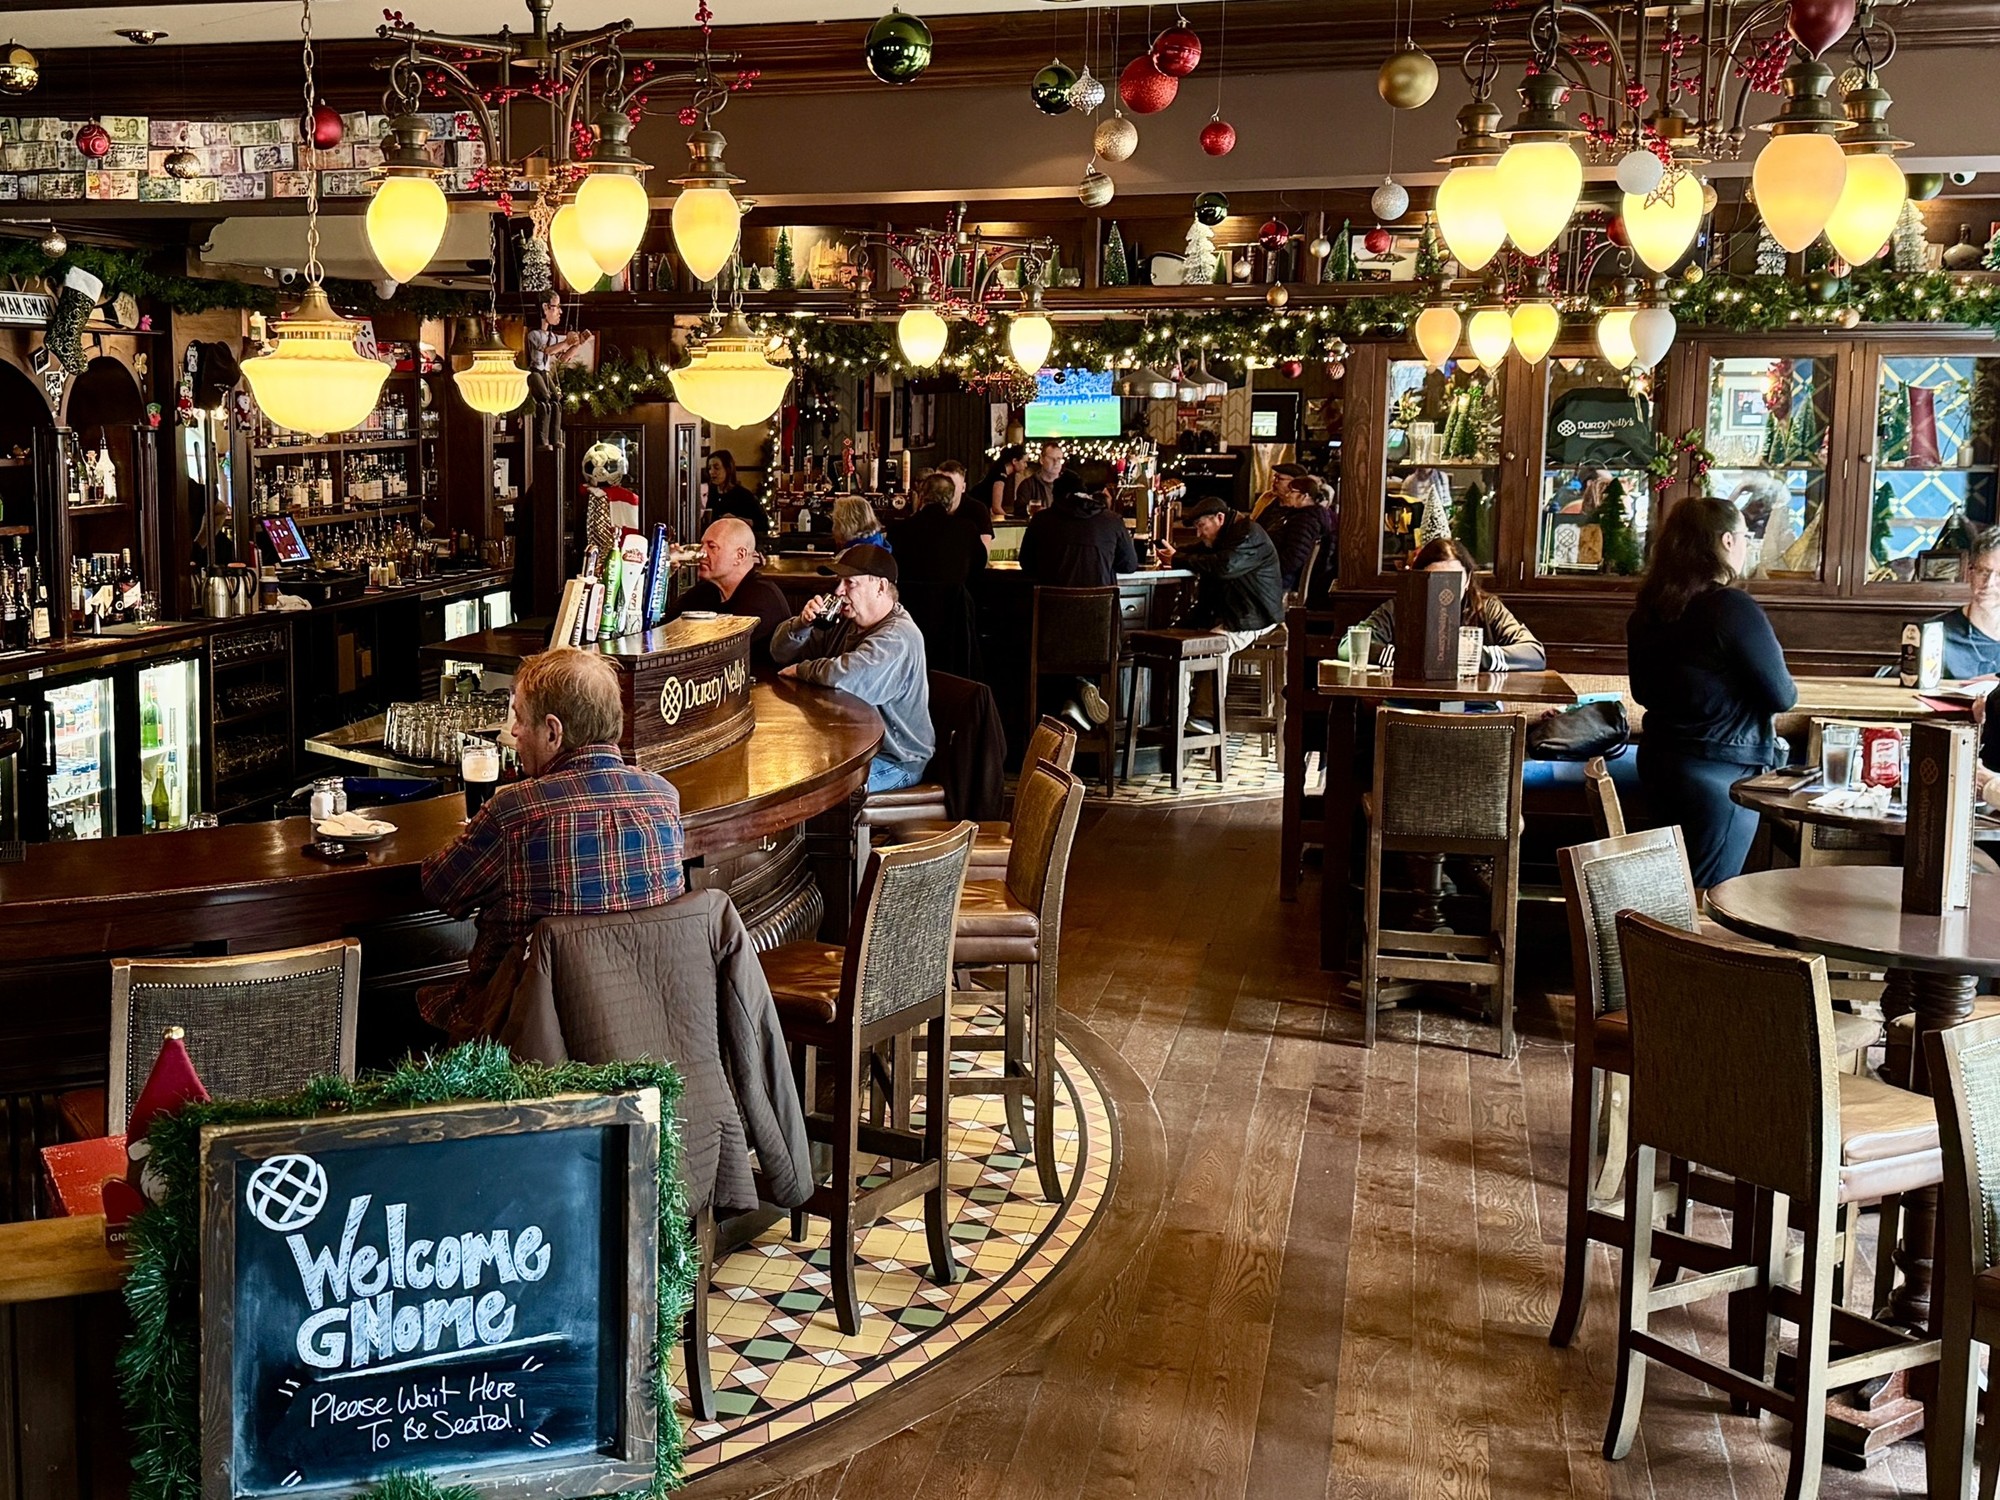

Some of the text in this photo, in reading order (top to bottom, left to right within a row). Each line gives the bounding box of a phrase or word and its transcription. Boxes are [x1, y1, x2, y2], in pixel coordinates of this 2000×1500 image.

[286, 1194, 551, 1310] Welcome
[311, 1372, 517, 1427] Please Wait Here
[358, 1399, 525, 1451] To Be Seated!
